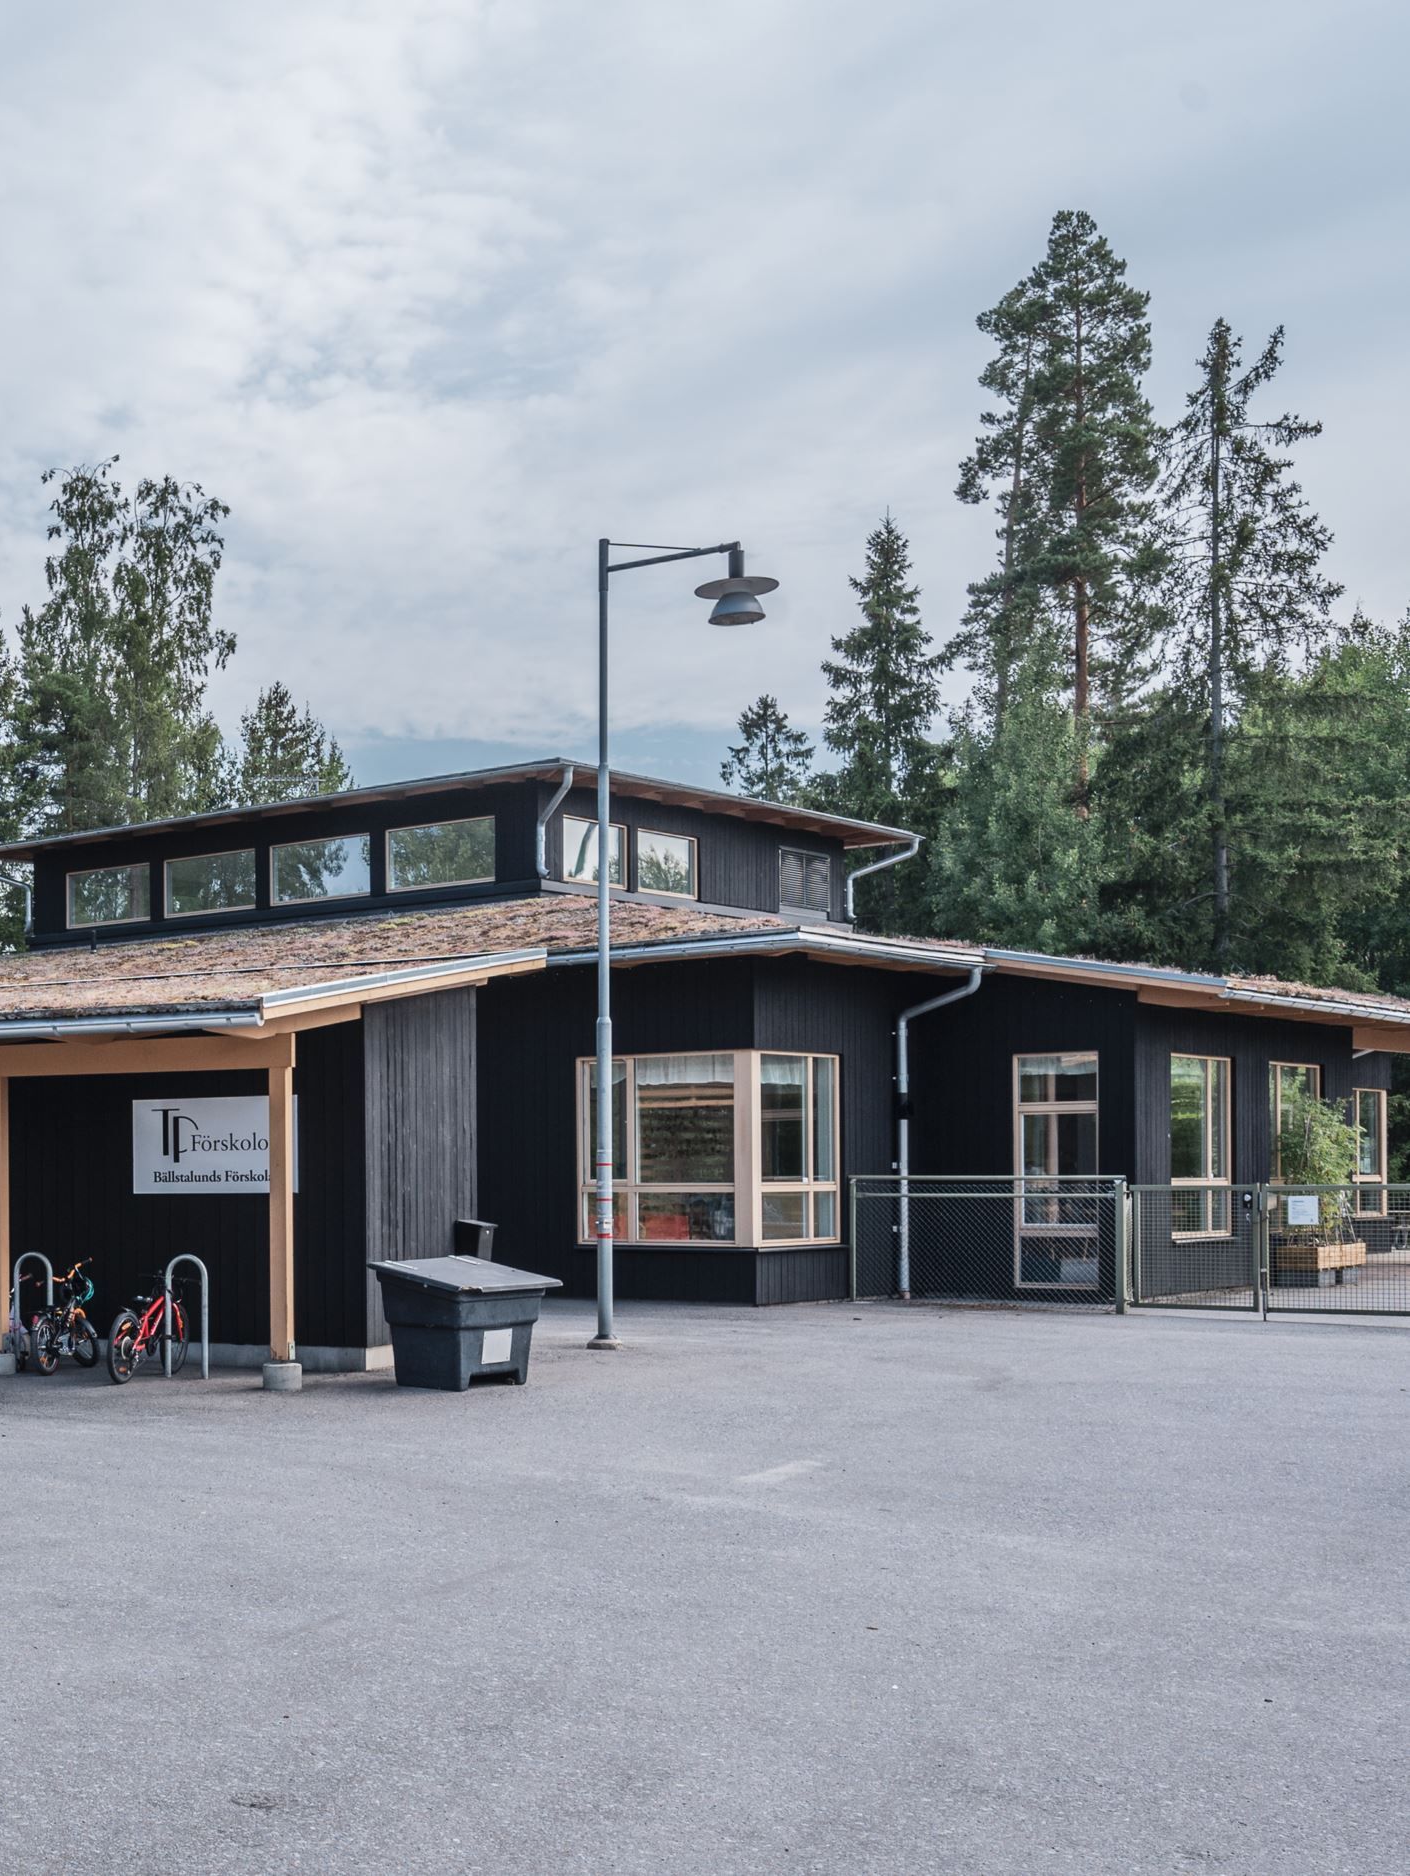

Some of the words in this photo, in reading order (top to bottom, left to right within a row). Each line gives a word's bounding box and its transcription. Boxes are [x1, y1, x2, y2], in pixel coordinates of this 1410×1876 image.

[191, 1132, 269, 1151] Förskolo
[153, 1170, 222, 1183] Bällstalunds
[225, 1169, 270, 1182] Förskol
